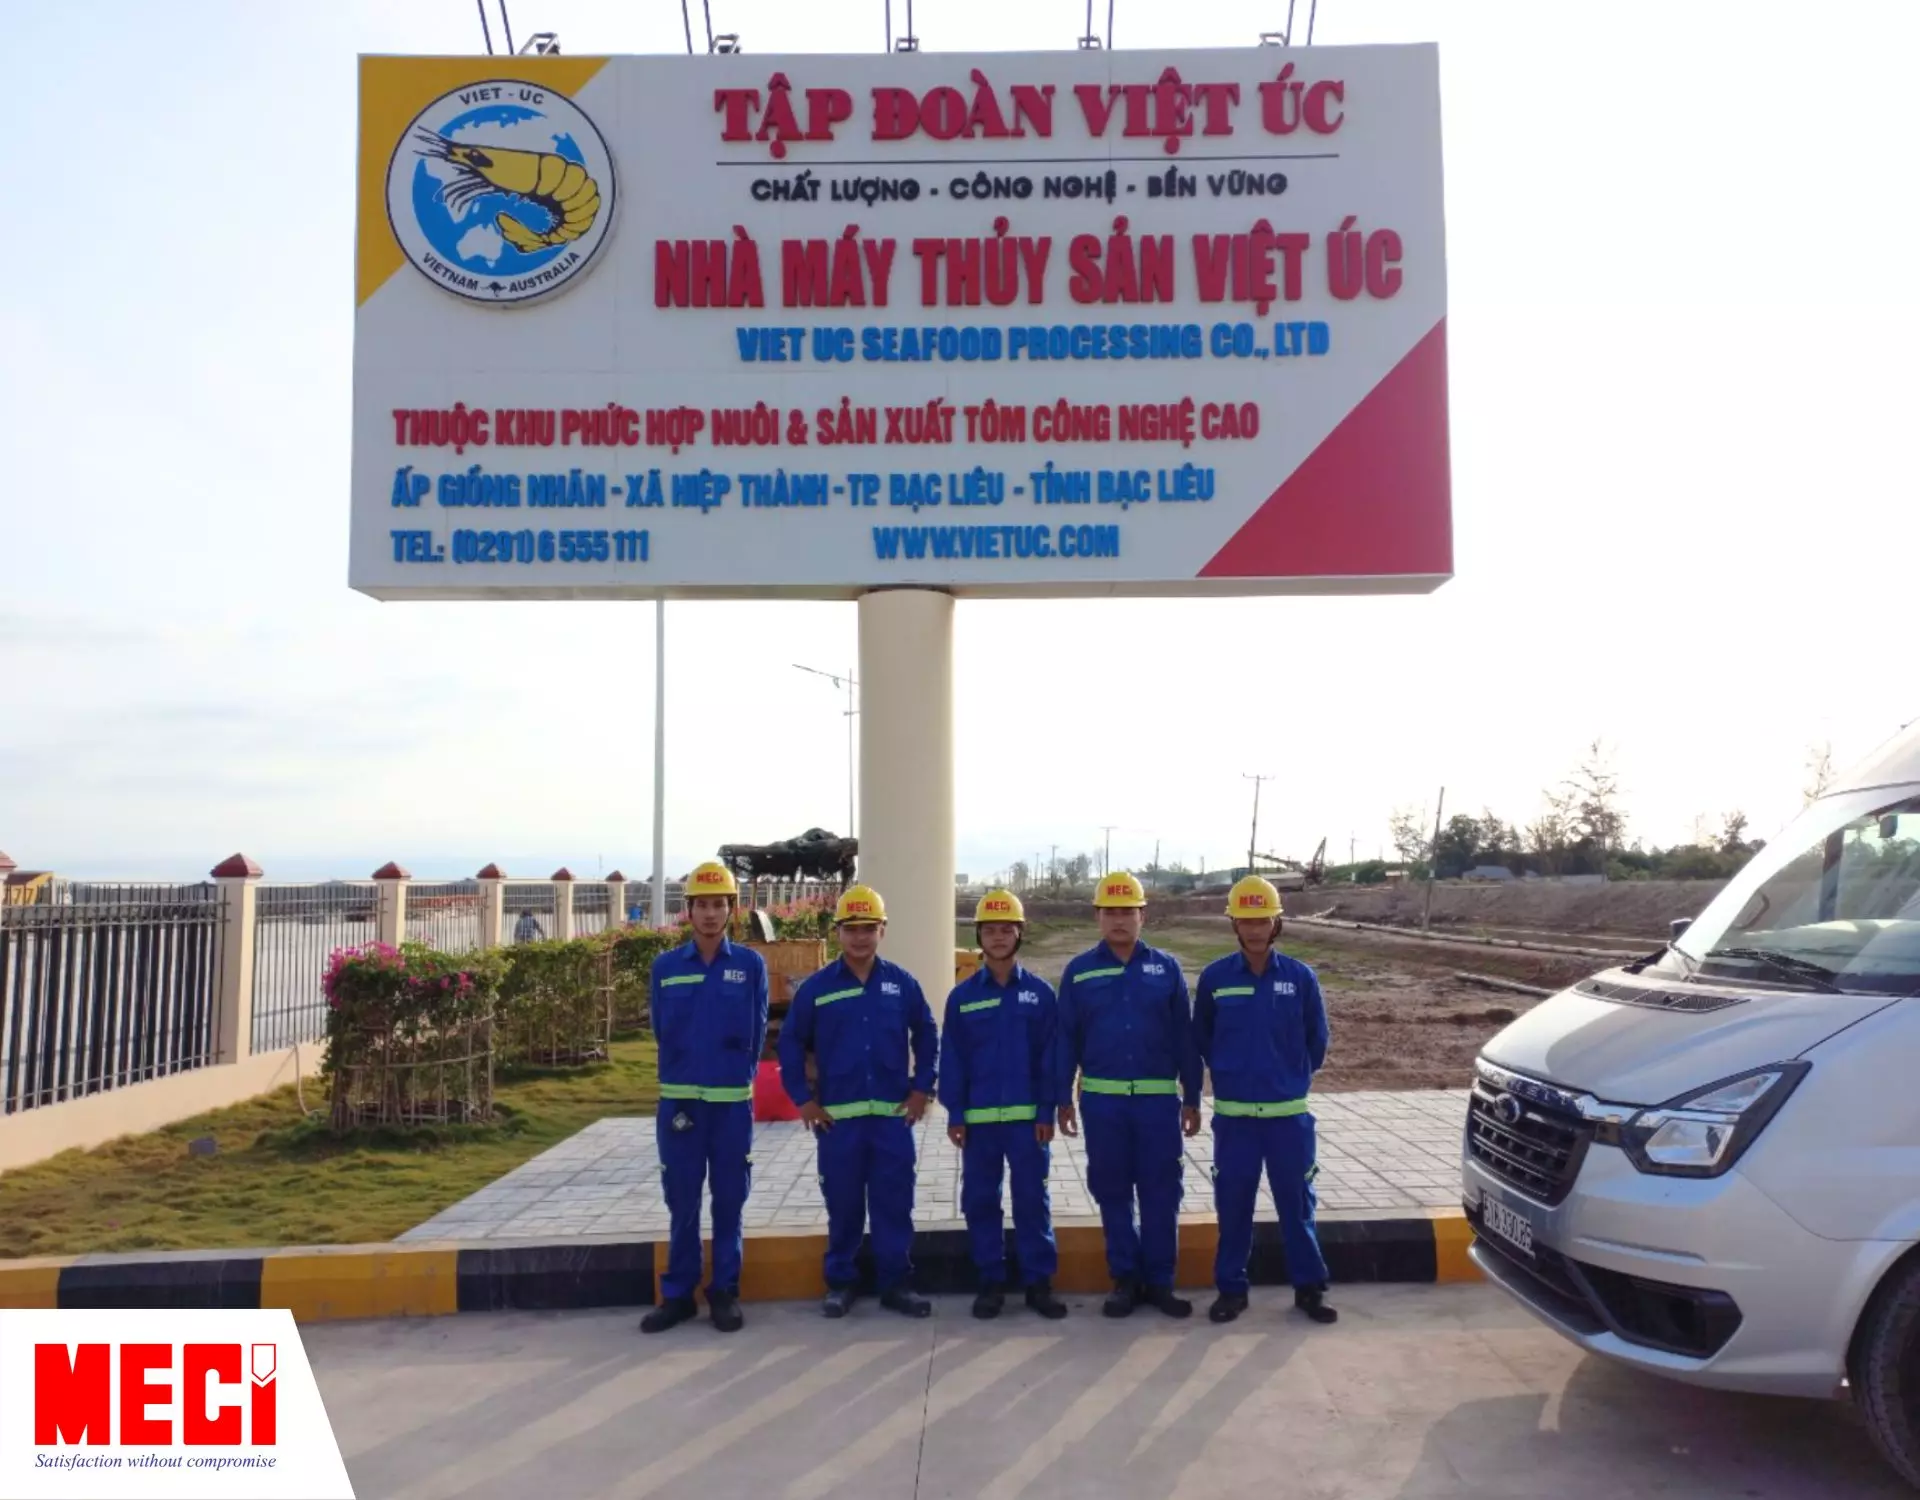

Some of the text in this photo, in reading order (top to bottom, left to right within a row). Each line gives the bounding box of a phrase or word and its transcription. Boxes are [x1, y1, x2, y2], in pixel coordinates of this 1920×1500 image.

[459, 87, 502, 105] VIET
[519, 88, 544, 105] UC
[715, 62, 1344, 158] TẬP ĐOÀN VIỆT ÚC
[751, 169, 821, 202] CHẤT
[831, 176, 920, 207] LƯỢNG
[949, 170, 1033, 199] CÔNG
[1044, 170, 1117, 204] NGHỆ
[1207, 169, 1288, 197] VỮNG
[423, 251, 580, 293] VIETNAM AUSTRALIA
[655, 215, 1403, 316] NHÀ MÁY THỦY SẢN VIỆT ÚC
[736, 326, 805, 361] VIET
[812, 326, 856, 362] UC
[861, 325, 1002, 361] SEAFOOD
[1008, 323, 1204, 360] PROCESSING
[1275, 320, 1331, 356] LTD
[392, 396, 1260, 454] THUỘC KHU PHỨC HỢP NUÔI & SẢN XUẤT TÔM CÔNG NGHỆ CAO
[391, 465, 431, 507] ẤP
[526, 468, 607, 507] NHÃN
[625, 468, 665, 507] XÃ
[671, 467, 732, 514] HIỆP
[738, 468, 829, 507] THÀNH
[889, 471, 943, 513] BẠC
[948, 465, 1007, 506] LIÊU
[1030, 460, 1093, 505] TỈNH
[1097, 468, 1152, 510] BẠC
[1157, 461, 1216, 502] LIÊU
[390, 530, 445, 562] TEL:
[612, 528, 650, 562] 111
